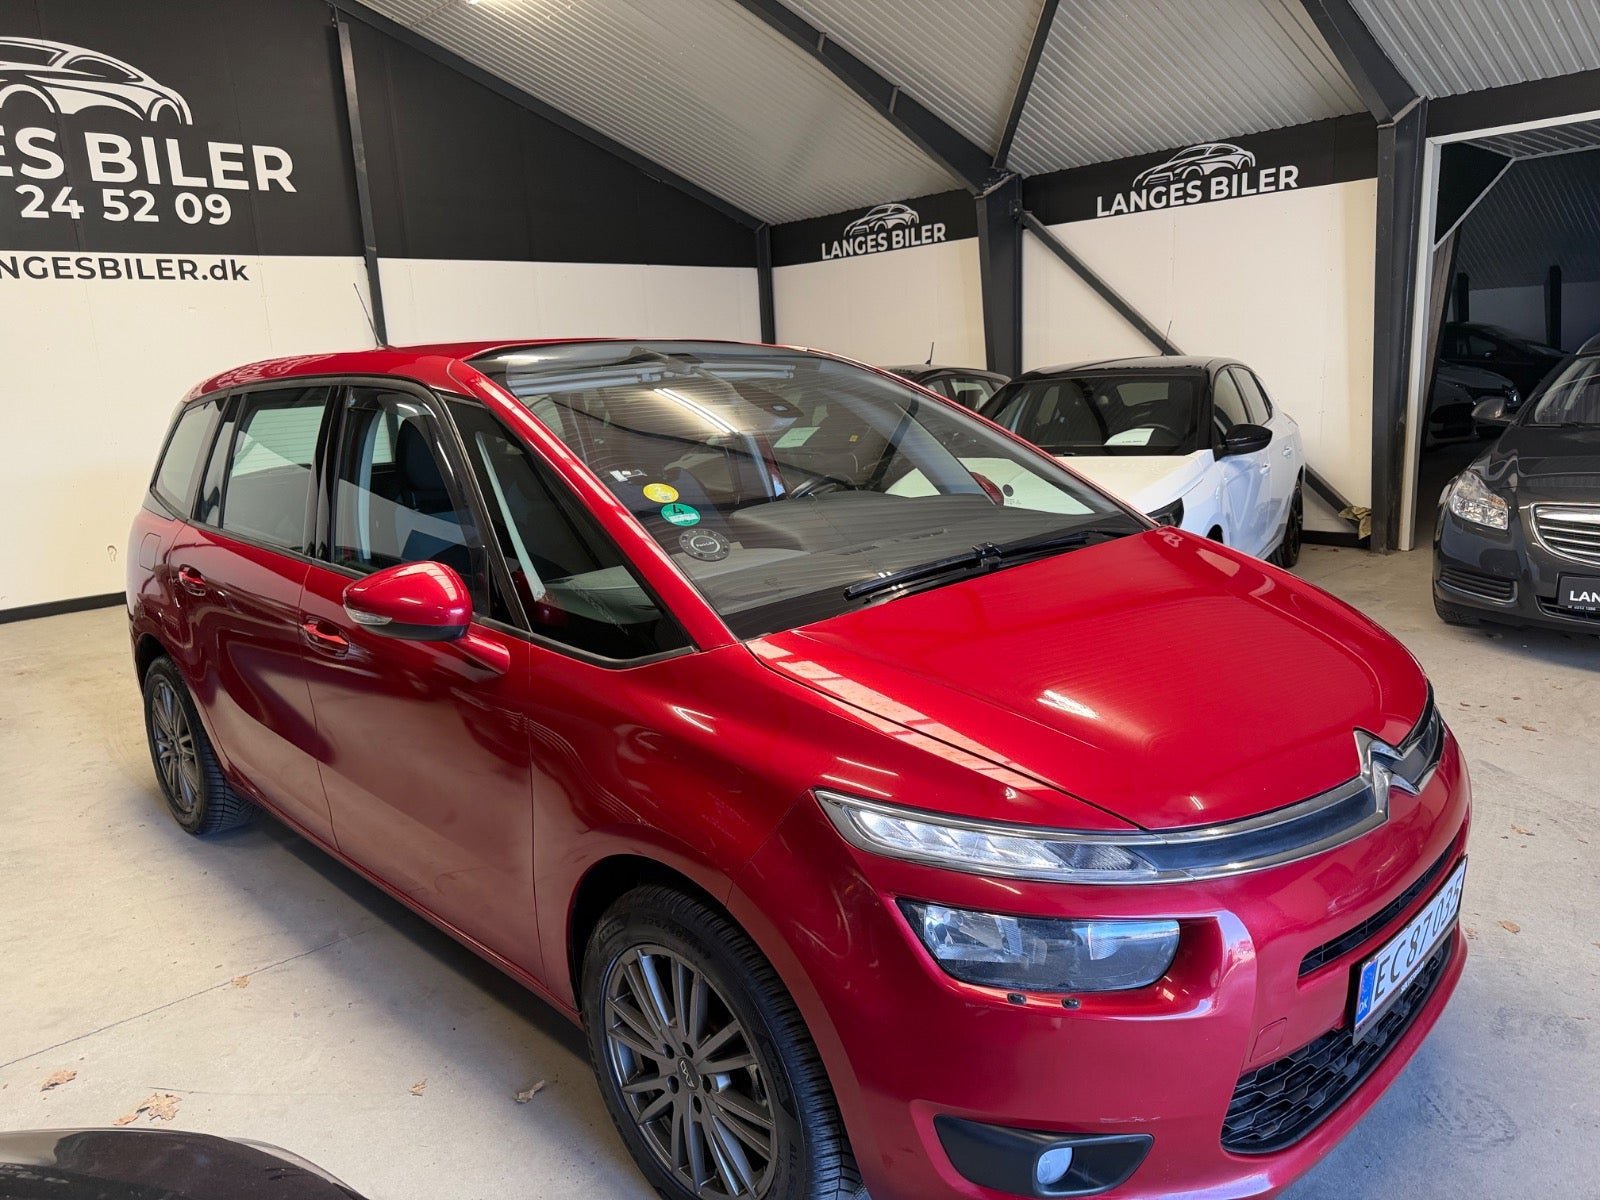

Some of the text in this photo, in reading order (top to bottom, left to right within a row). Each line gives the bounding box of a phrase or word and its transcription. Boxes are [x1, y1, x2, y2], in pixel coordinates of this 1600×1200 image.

[84, 131, 297, 193] BILER
[15, 184, 232, 225] 24 52 09
[1096, 164, 1299, 217] LANGES BILER
[821, 222, 946, 260] LANGES BILER
[0, 256, 250, 281] NGESBILER.dk
[1374, 940, 1406, 1002] EC
[1406, 911, 1432, 968] 87
